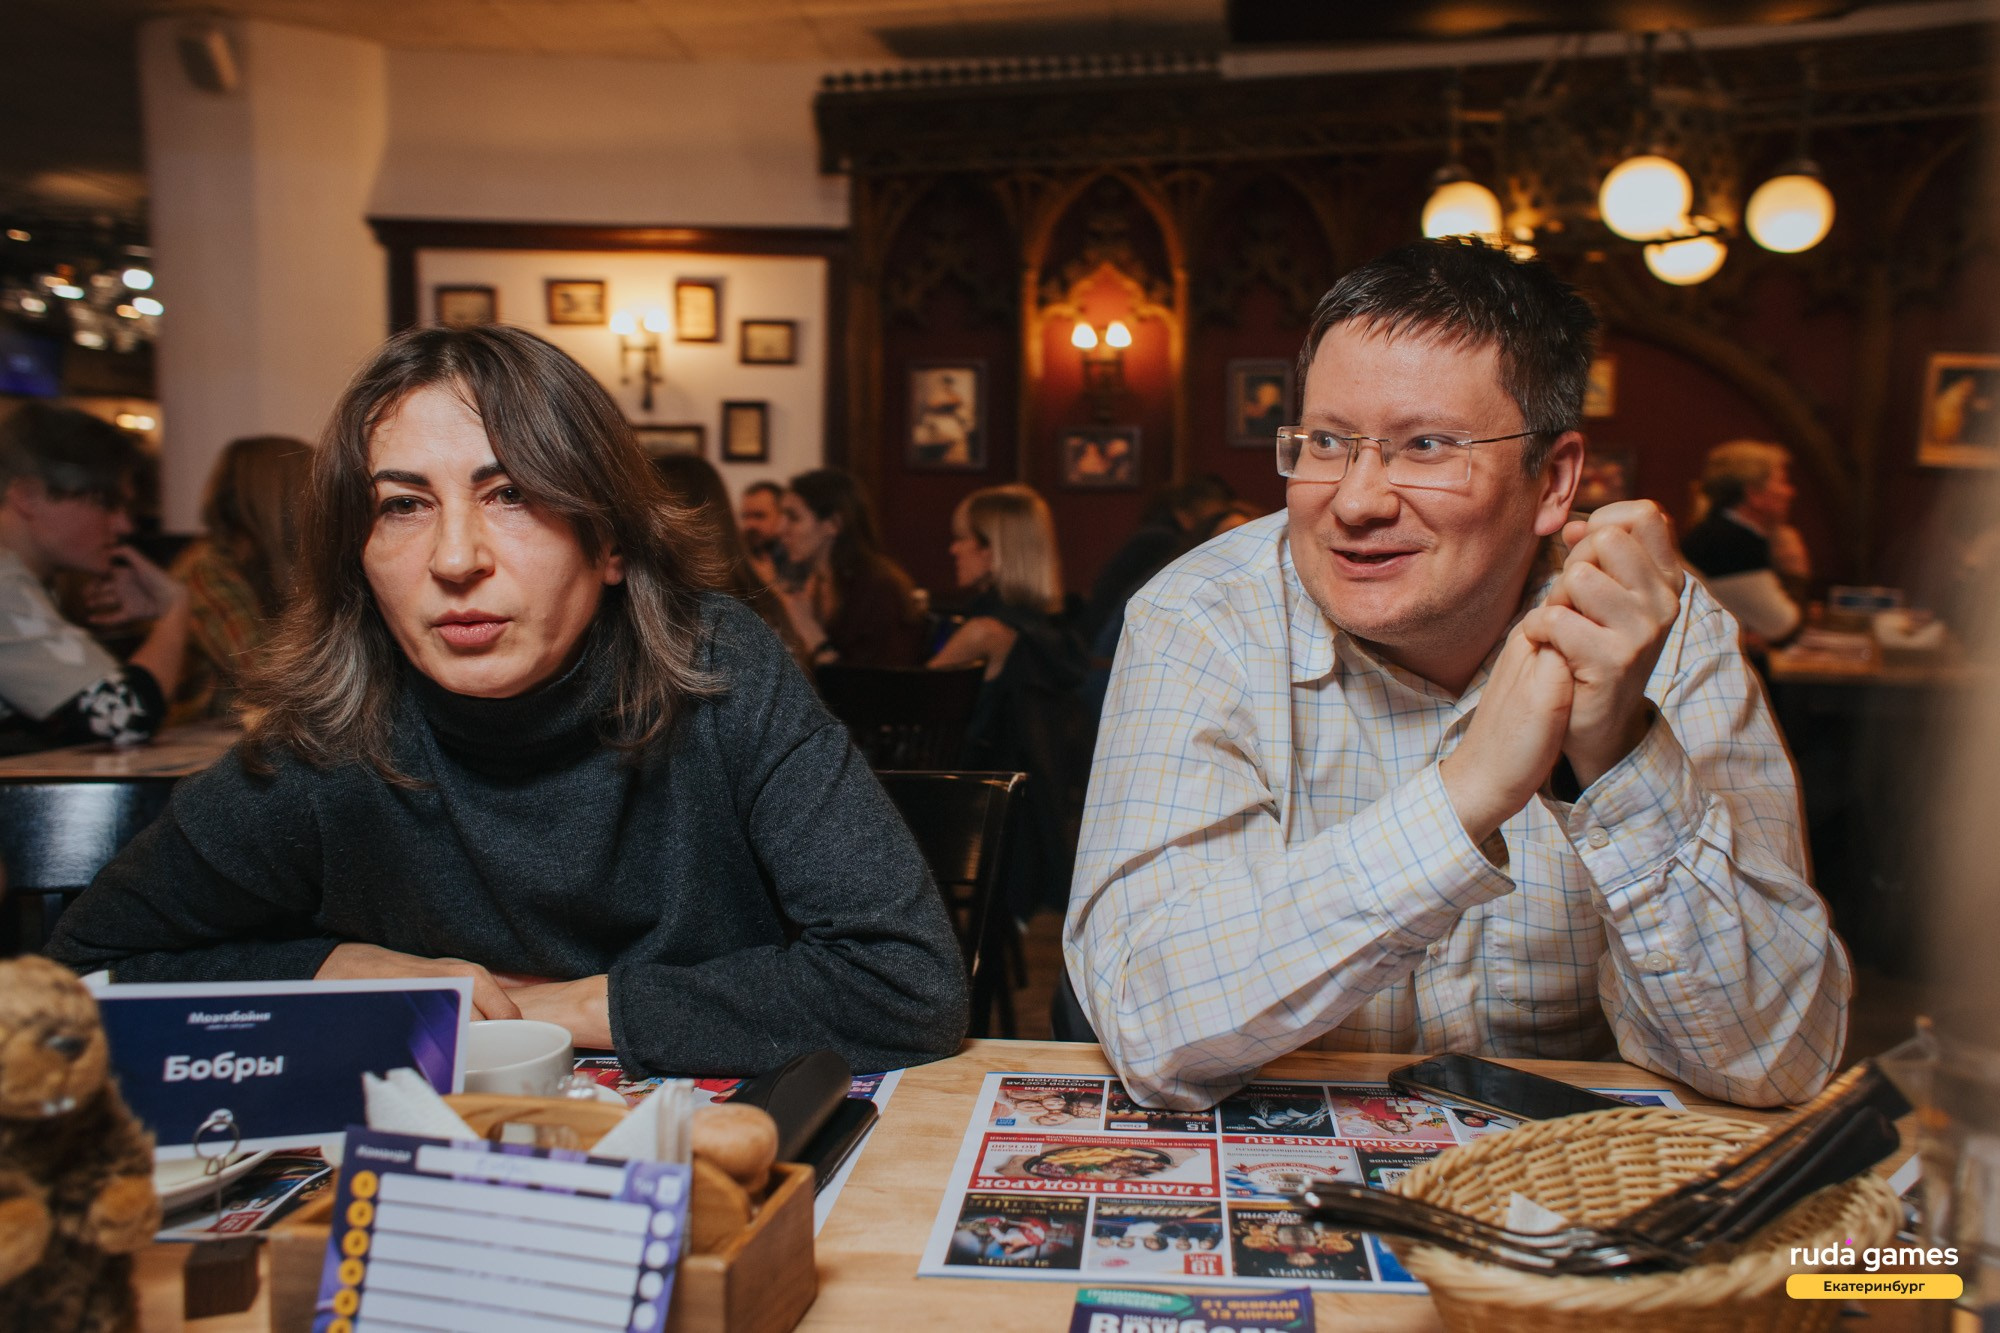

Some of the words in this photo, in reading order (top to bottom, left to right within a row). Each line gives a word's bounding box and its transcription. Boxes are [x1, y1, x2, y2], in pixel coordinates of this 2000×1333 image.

[188, 1010, 272, 1024] Мозгобойня
[163, 1051, 284, 1084] Бобры
[1244, 1137, 1438, 1149] MAXIMILIANS.RU
[975, 1178, 1099, 1192] ПОДАРОК
[1102, 1182, 1112, 1193] В
[1122, 1183, 1194, 1194] ЛАНЧ
[1198, 1186, 1214, 1195] 6
[1191, 1261, 1218, 1274] 19
[1227, 1299, 1300, 1311] ФЕВРАЛЯ
[1234, 1309, 1296, 1320] АПРЕЛЯ
